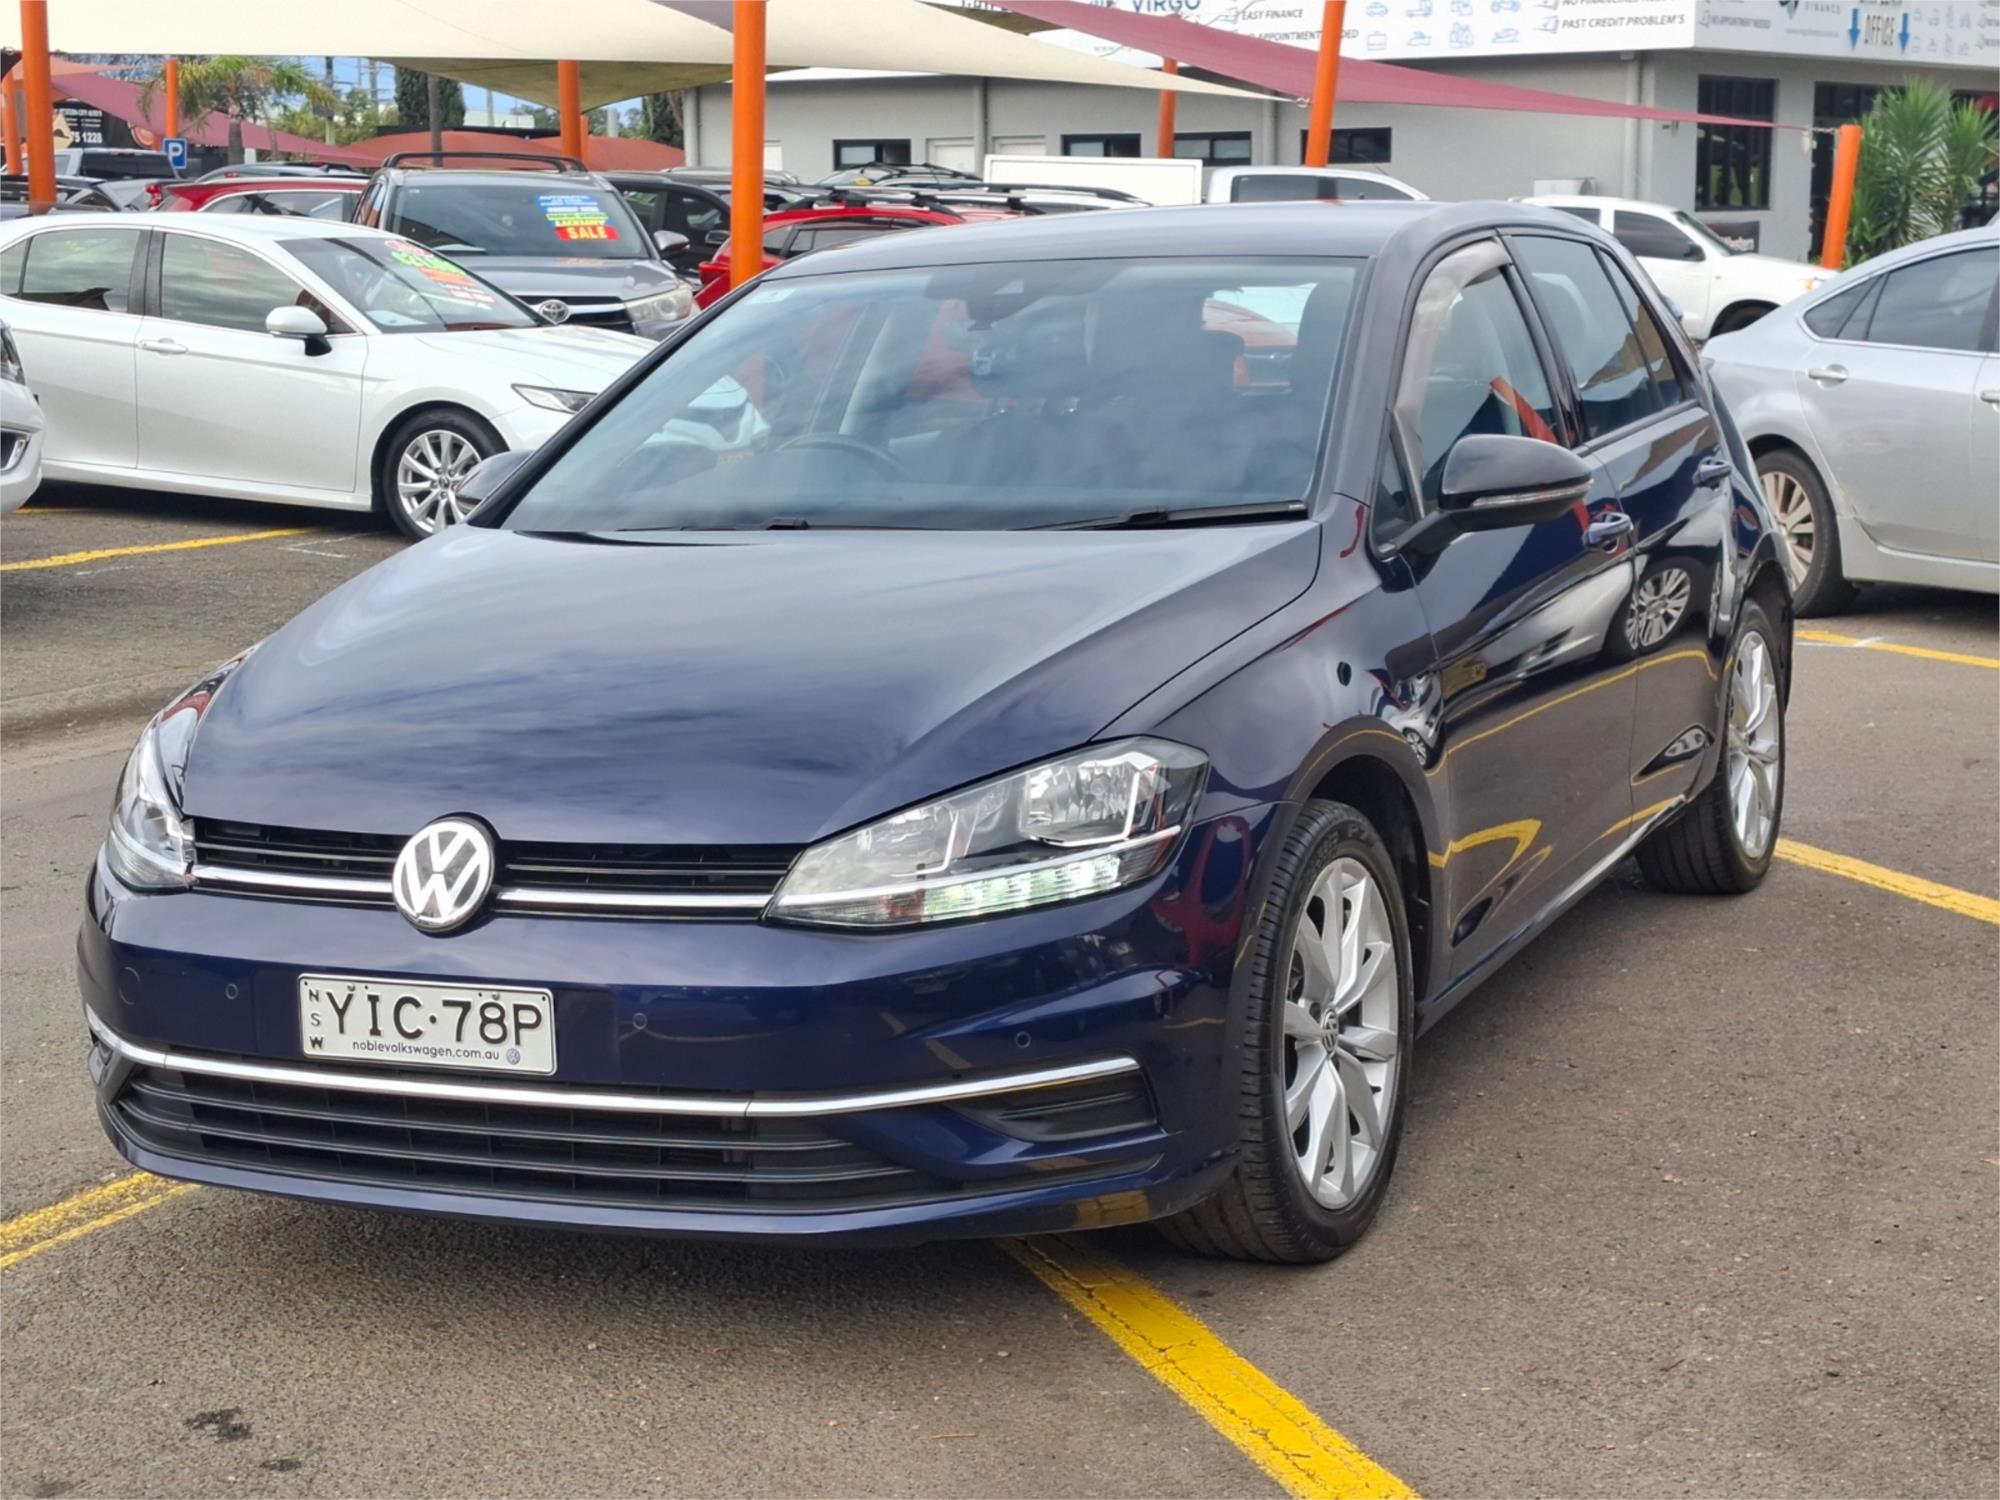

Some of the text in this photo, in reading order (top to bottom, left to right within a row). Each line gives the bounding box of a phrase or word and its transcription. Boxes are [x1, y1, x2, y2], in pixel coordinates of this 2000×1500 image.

[1242, 8, 1304, 20] EASY FINANCE
[1562, 14, 1685, 29] PAST CREDIT PROBLEM'S
[1864, 15, 1896, 47] OFFICE
[169, 142, 183, 161] P
[566, 226, 608, 239] SALE
[352, 1040, 500, 1060] noblevolkswagen.com.au
